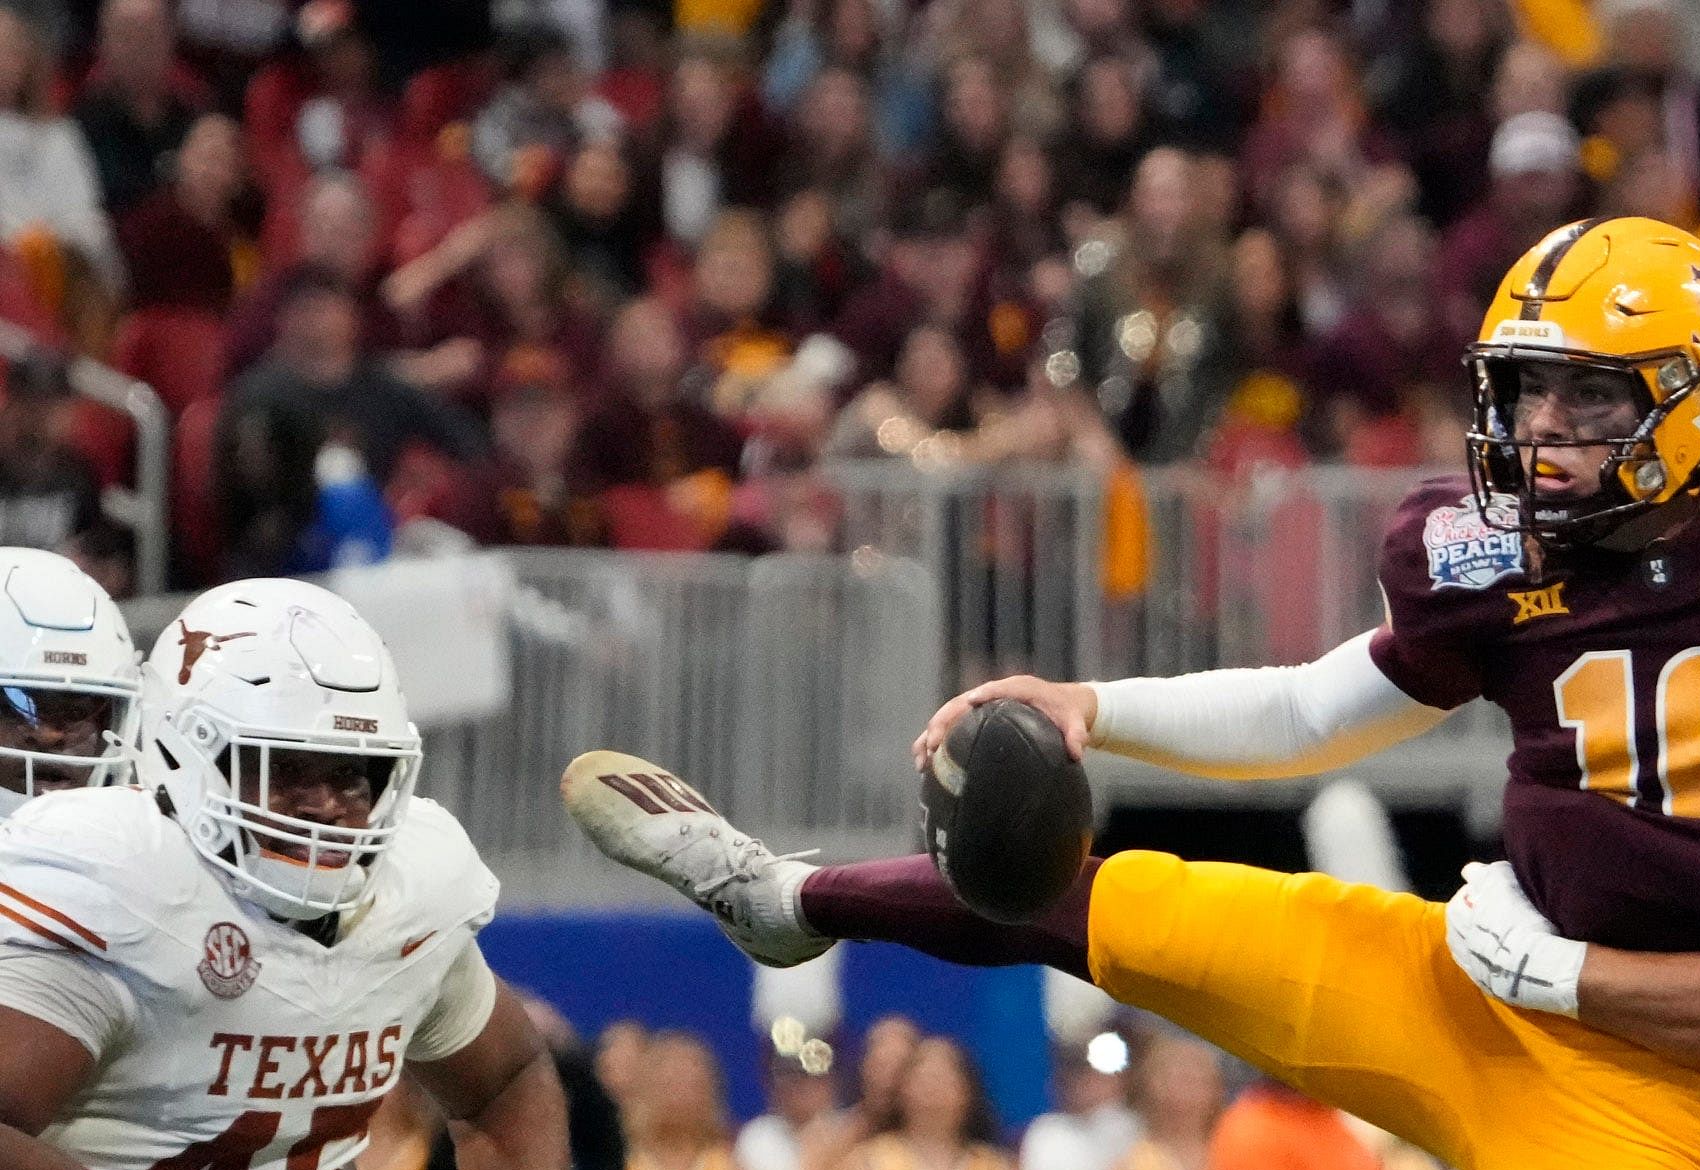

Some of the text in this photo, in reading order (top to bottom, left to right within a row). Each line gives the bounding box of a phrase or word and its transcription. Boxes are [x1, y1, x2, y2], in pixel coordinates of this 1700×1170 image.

[1431, 532, 1518, 575] PEACH
[1450, 557, 1504, 575] BOWL
[1507, 582, 1570, 625] XII
[43, 650, 87, 666] HORNS
[333, 714, 378, 734] HORNS
[207, 926, 247, 978] SEC
[206, 1024, 402, 1099] TEXAS
